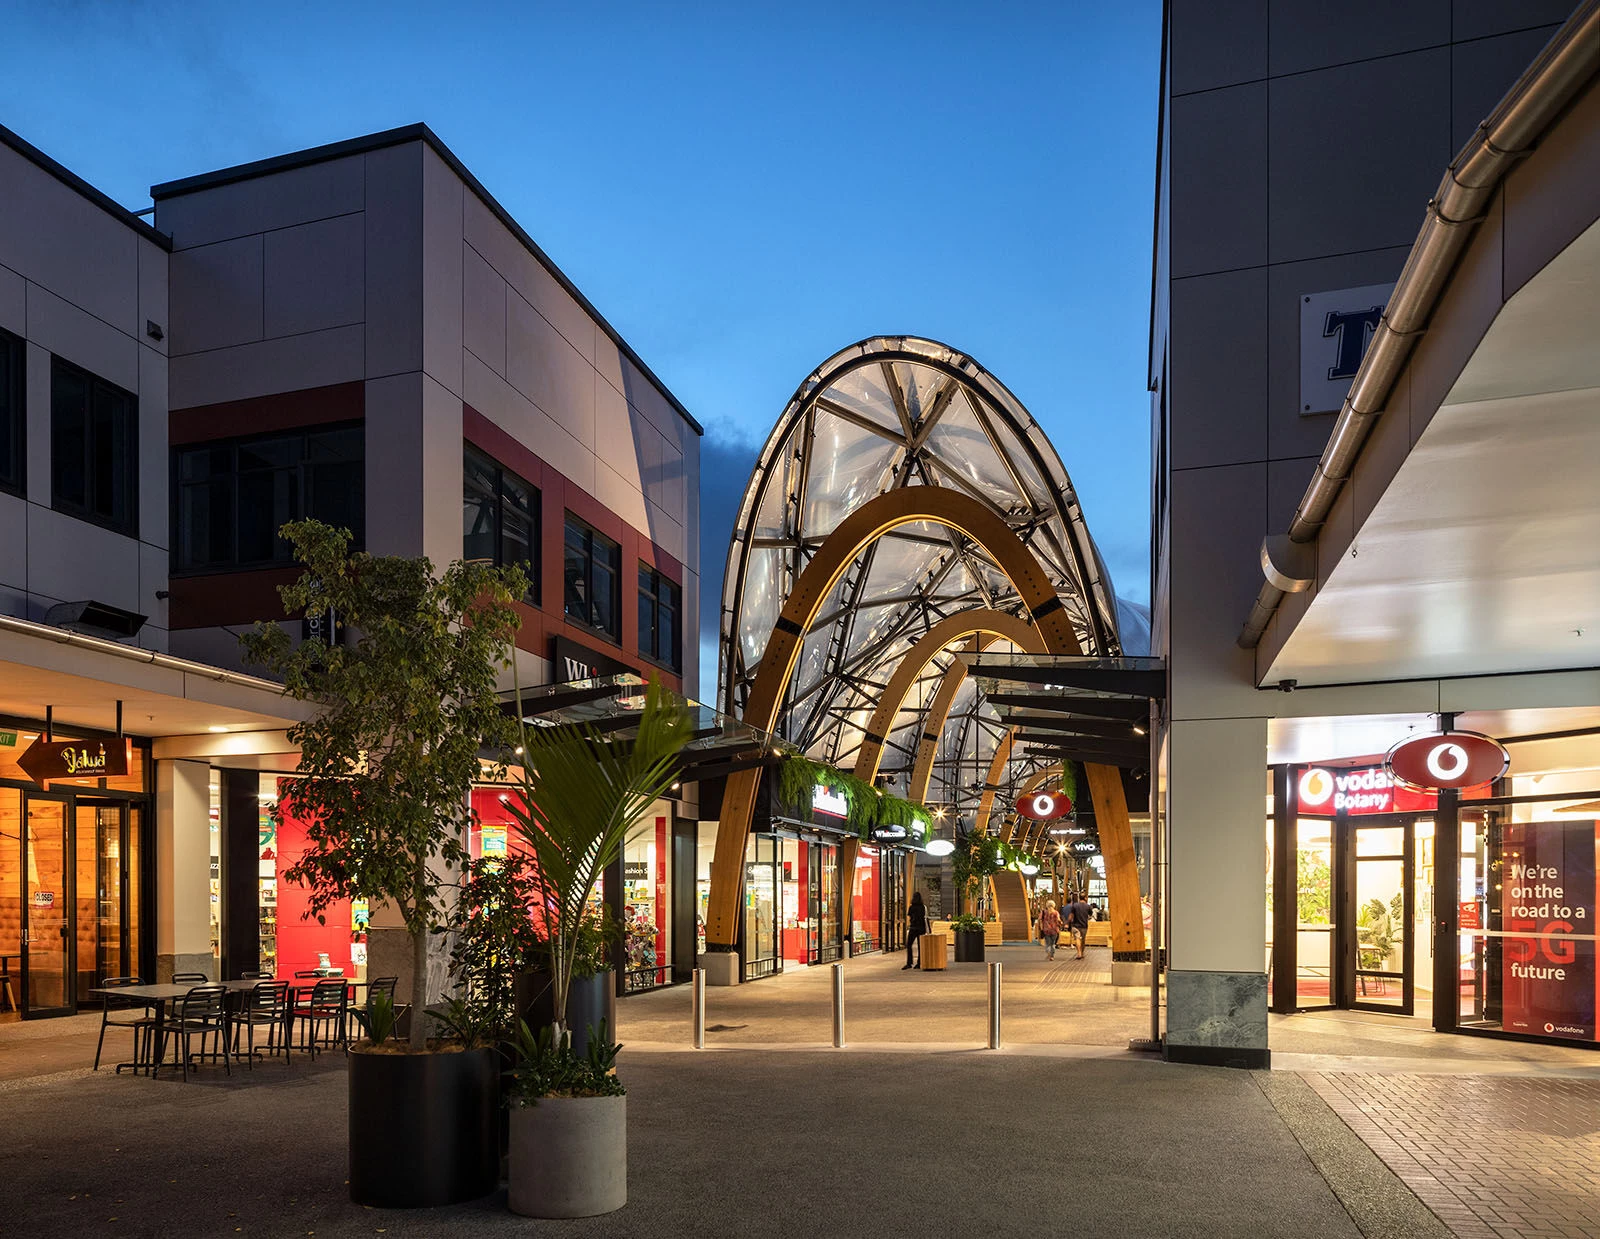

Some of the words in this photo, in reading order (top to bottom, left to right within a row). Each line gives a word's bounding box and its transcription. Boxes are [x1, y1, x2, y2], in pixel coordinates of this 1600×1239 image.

[1335, 768, 1394, 792] voda
[1334, 792, 1390, 810] Botany
[1074, 841, 1096, 851] vivo
[1511, 886, 1532, 899] on
[1534, 883, 1563, 899] the
[1511, 903, 1549, 918] road
[1552, 904, 1572, 918] to
[1575, 907, 1586, 919] a
[1510, 920, 1576, 965] 5G
[1511, 963, 1566, 981] future
[1555, 1026, 1585, 1035] vodafone
